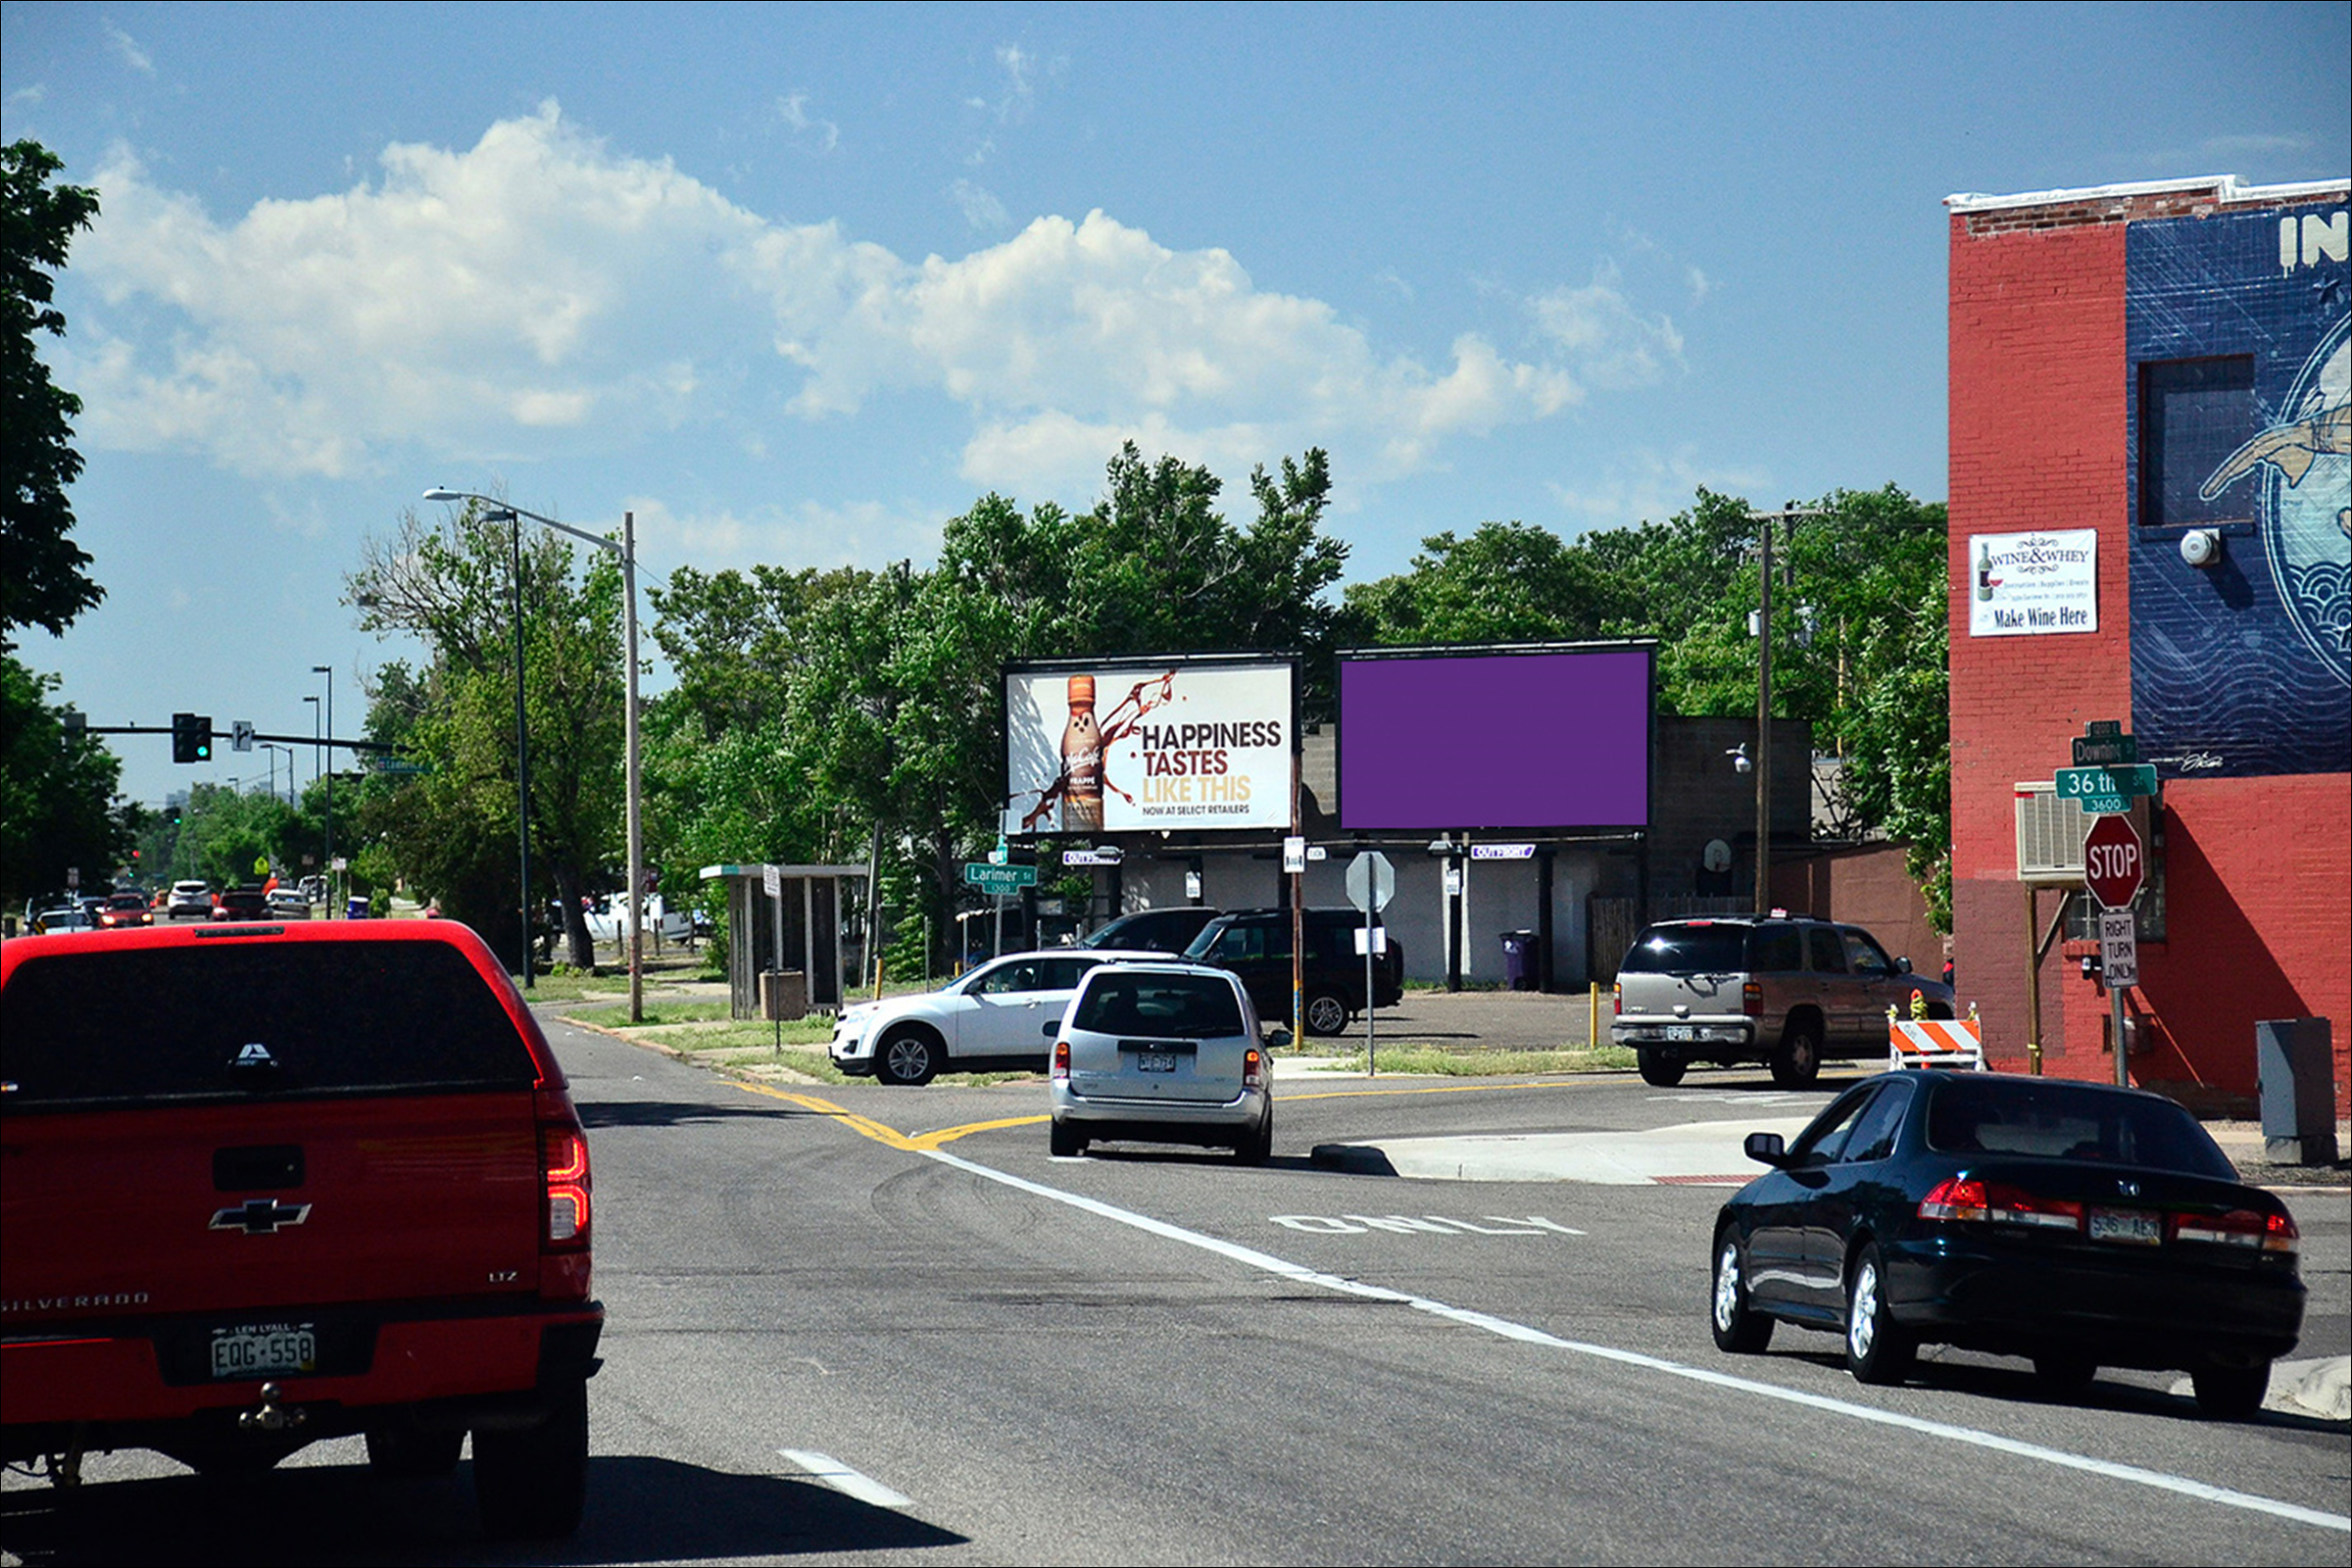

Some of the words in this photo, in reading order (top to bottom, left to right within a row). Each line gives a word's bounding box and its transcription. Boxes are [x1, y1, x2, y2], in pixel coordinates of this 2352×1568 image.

[2278, 211, 2349, 270] IN
[1994, 610, 2025, 627] Make
[2028, 608, 2056, 626] Wine
[2060, 607, 2088, 625] Here
[1143, 721, 1282, 750] HAPPINESS
[2076, 740, 2122, 762] Downing
[1143, 750, 1228, 776] TASTES
[1143, 777, 1192, 803] LIKE
[1198, 775, 1251, 802] THIS
[2132, 775, 2143, 786] St
[1143, 806, 1163, 815] NOW
[1165, 806, 1176, 815] AT
[1177, 805, 1205, 815] SELECT
[1208, 804, 1250, 814] RETAILERS
[2091, 799, 2122, 811] 3600
[2089, 843, 2137, 880] STOP
[970, 867, 1017, 882] Larimer
[2105, 919, 2132, 938] RIGHT
[2107, 941, 2132, 958] TURN
[2107, 963, 2133, 980] ONLY
[488, 1270, 518, 1283] LTZ
[0, 1292, 149, 1312] SILVERADO
[235, 1325, 257, 1334] LEN
[260, 1323, 290, 1333] LYALL
